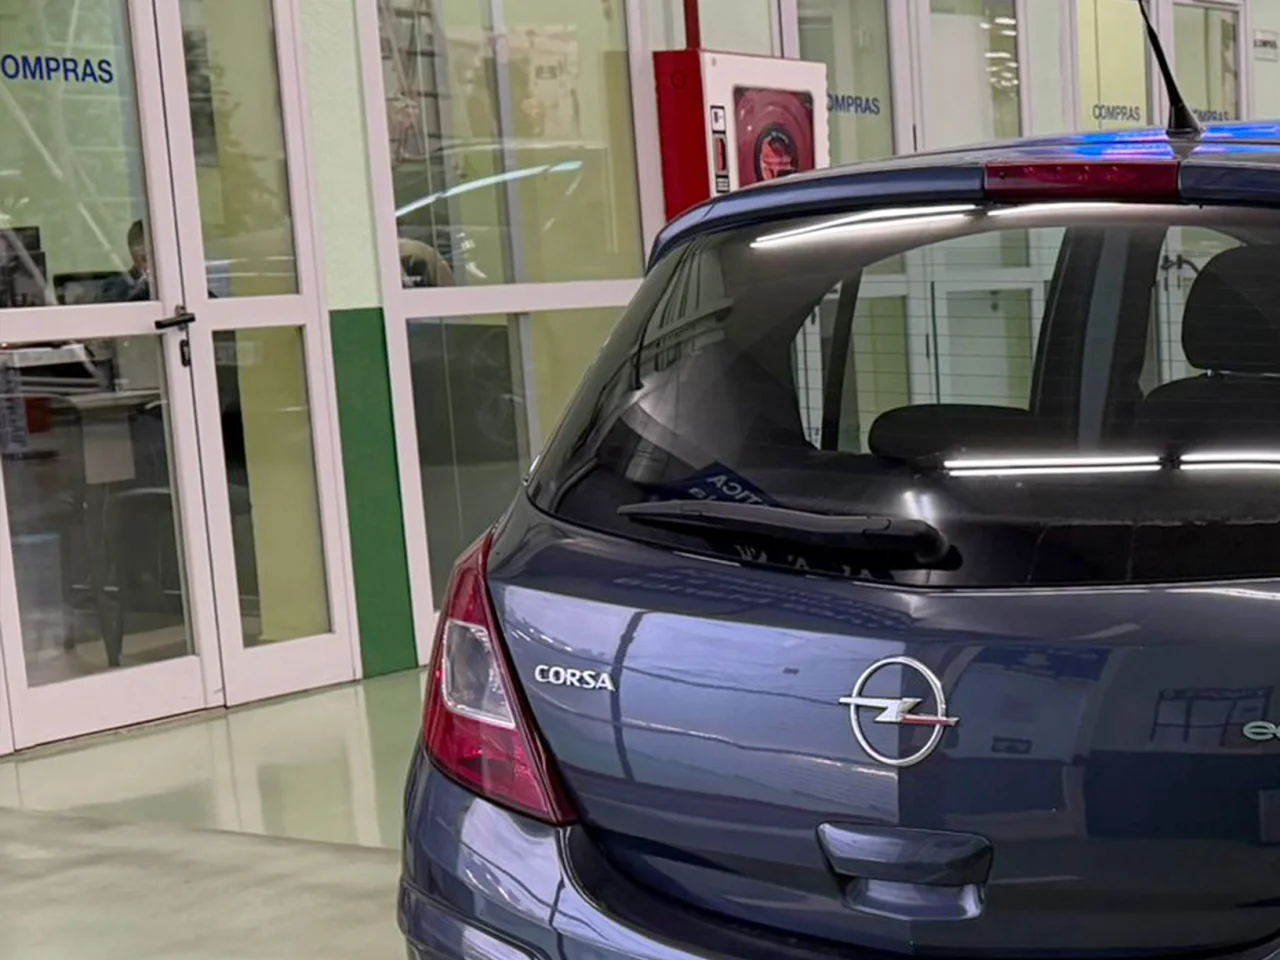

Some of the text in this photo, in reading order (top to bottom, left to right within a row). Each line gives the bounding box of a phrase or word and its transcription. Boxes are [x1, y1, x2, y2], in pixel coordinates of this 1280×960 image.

[0, 53, 114, 84] OMPRAS
[827, 93, 881, 116] OMPRAS
[1092, 104, 1141, 122] COMPRAS
[534, 664, 615, 691] CORSA
